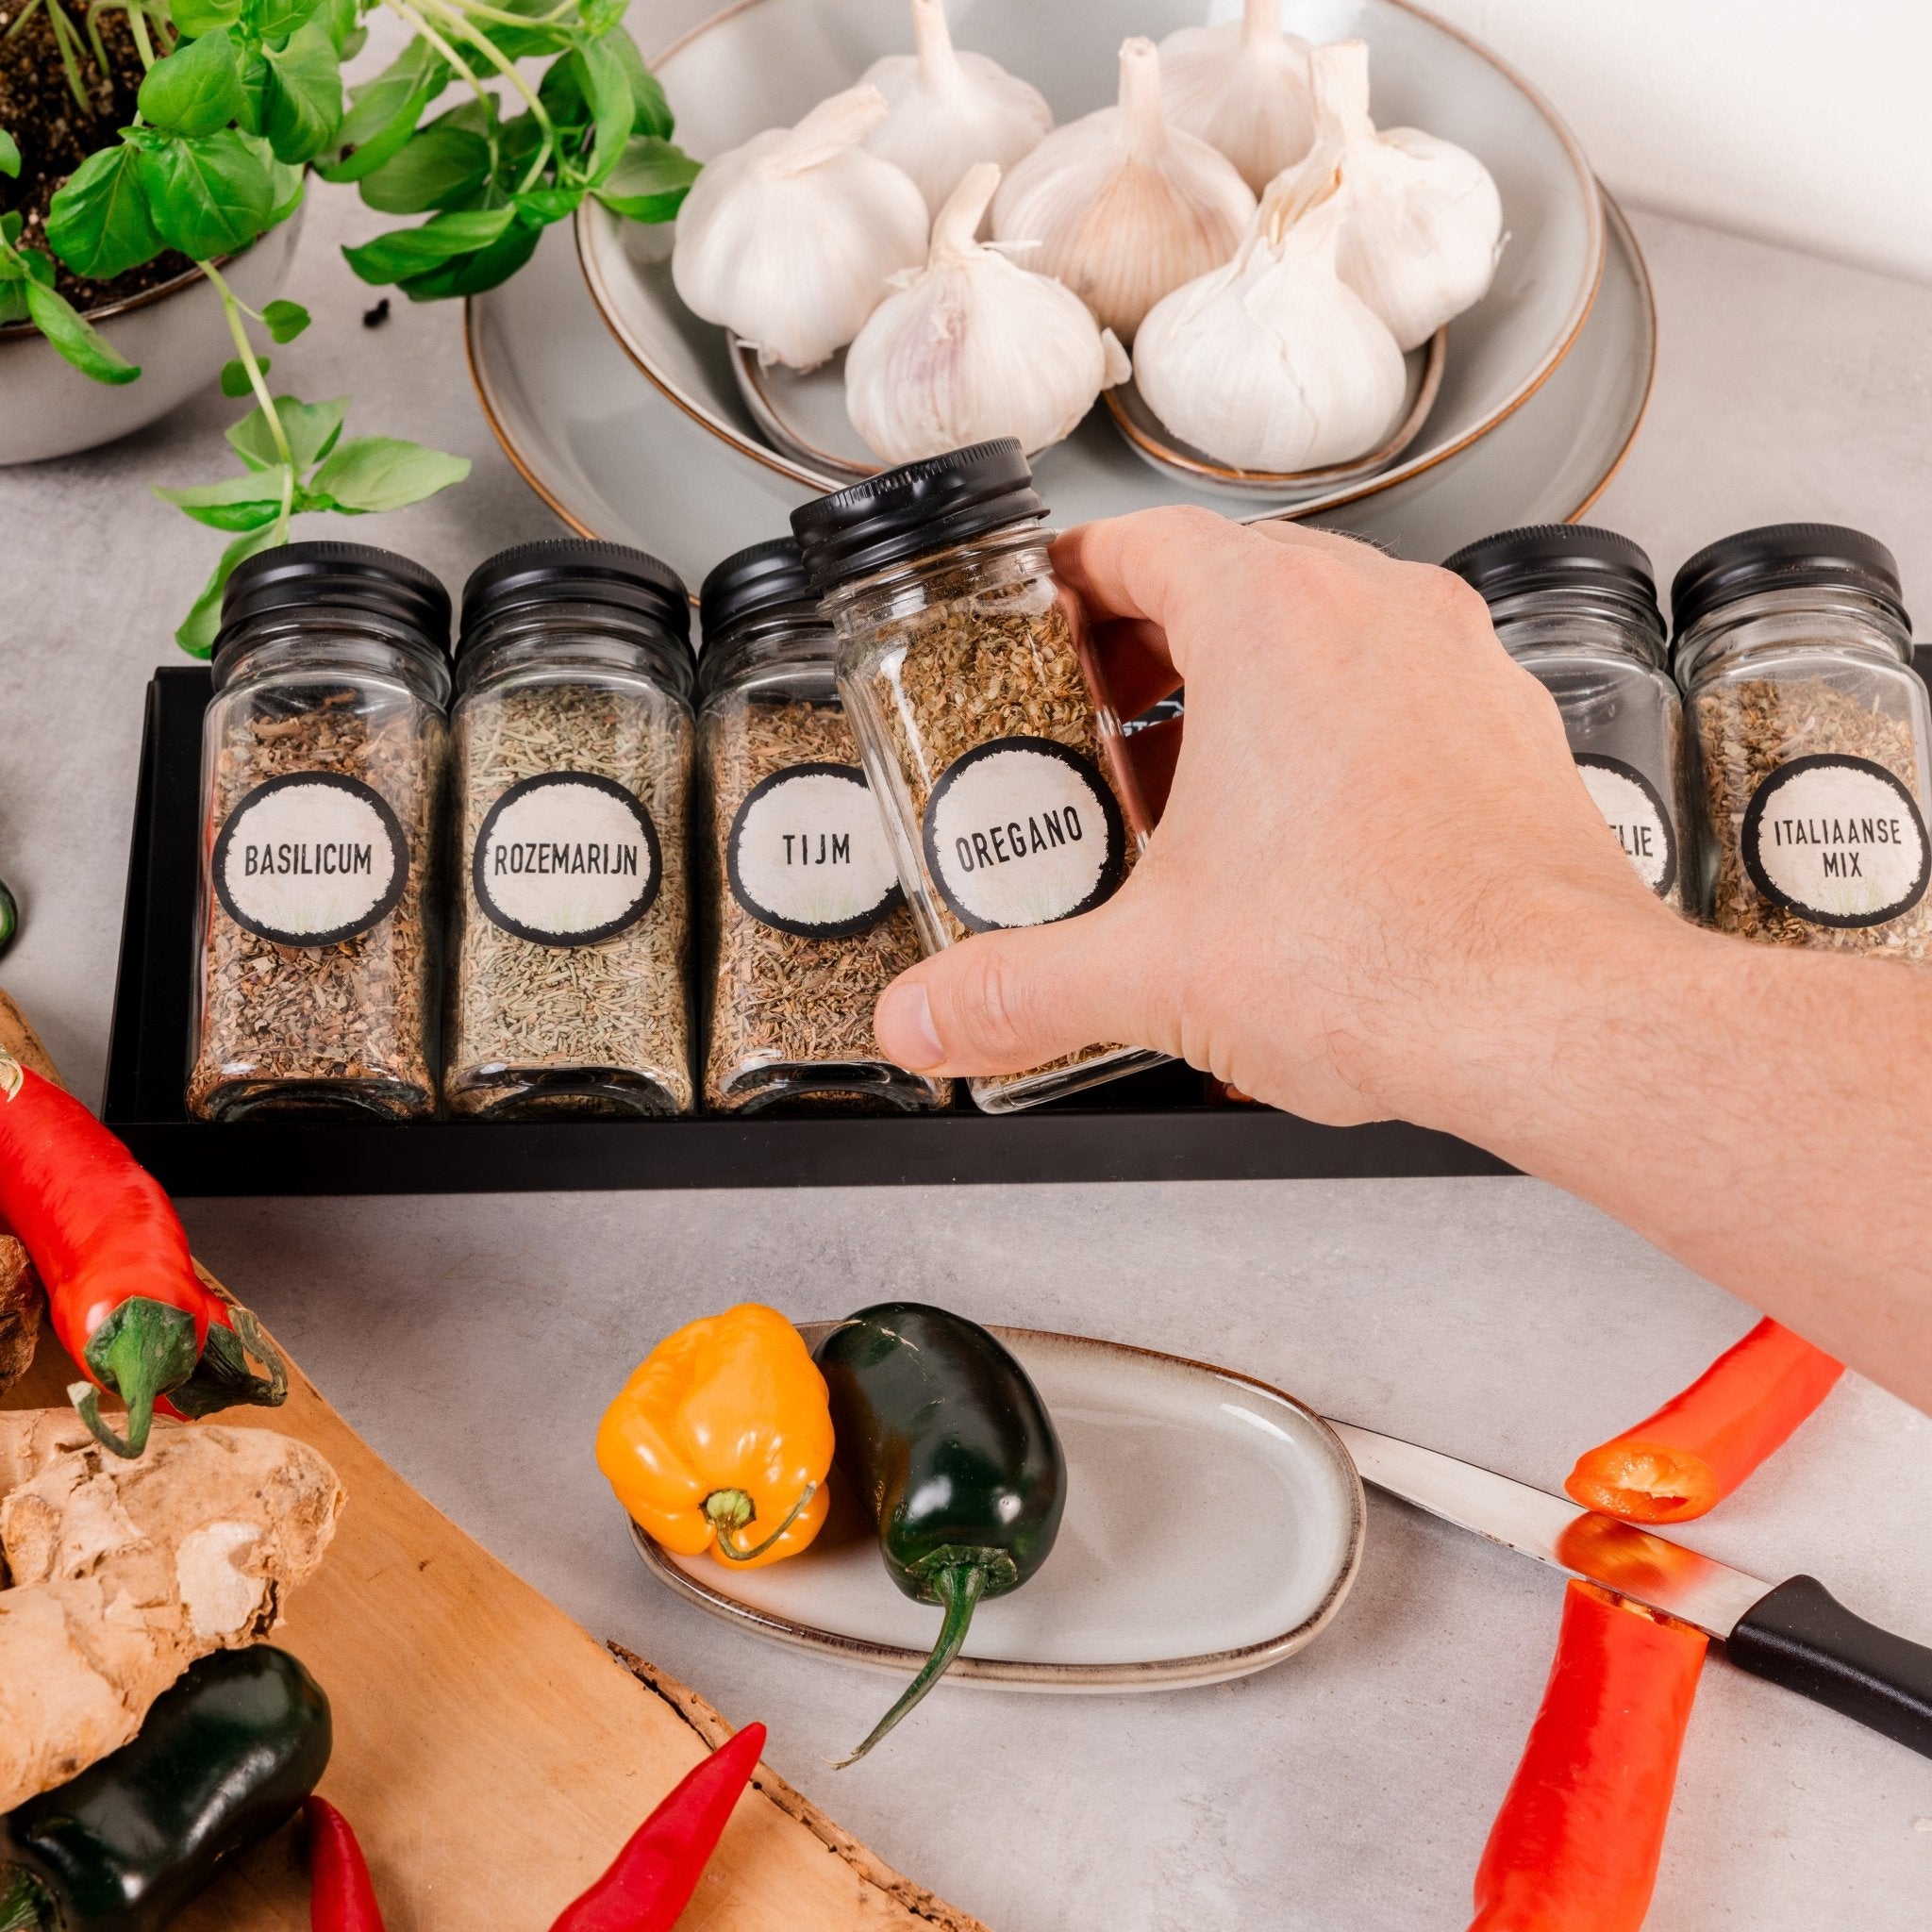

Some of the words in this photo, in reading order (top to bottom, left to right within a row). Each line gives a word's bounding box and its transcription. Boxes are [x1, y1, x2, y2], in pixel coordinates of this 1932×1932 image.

[955, 805, 1083, 873] OREGANO
[1607, 824, 1654, 858] LIE
[1774, 818, 1902, 846] ITALIAANSE
[244, 843, 373, 876] BASILICUM
[494, 842, 638, 876] ROZEMARIJN
[782, 833, 851, 865] TIJM
[1822, 852, 1862, 878] MIX
